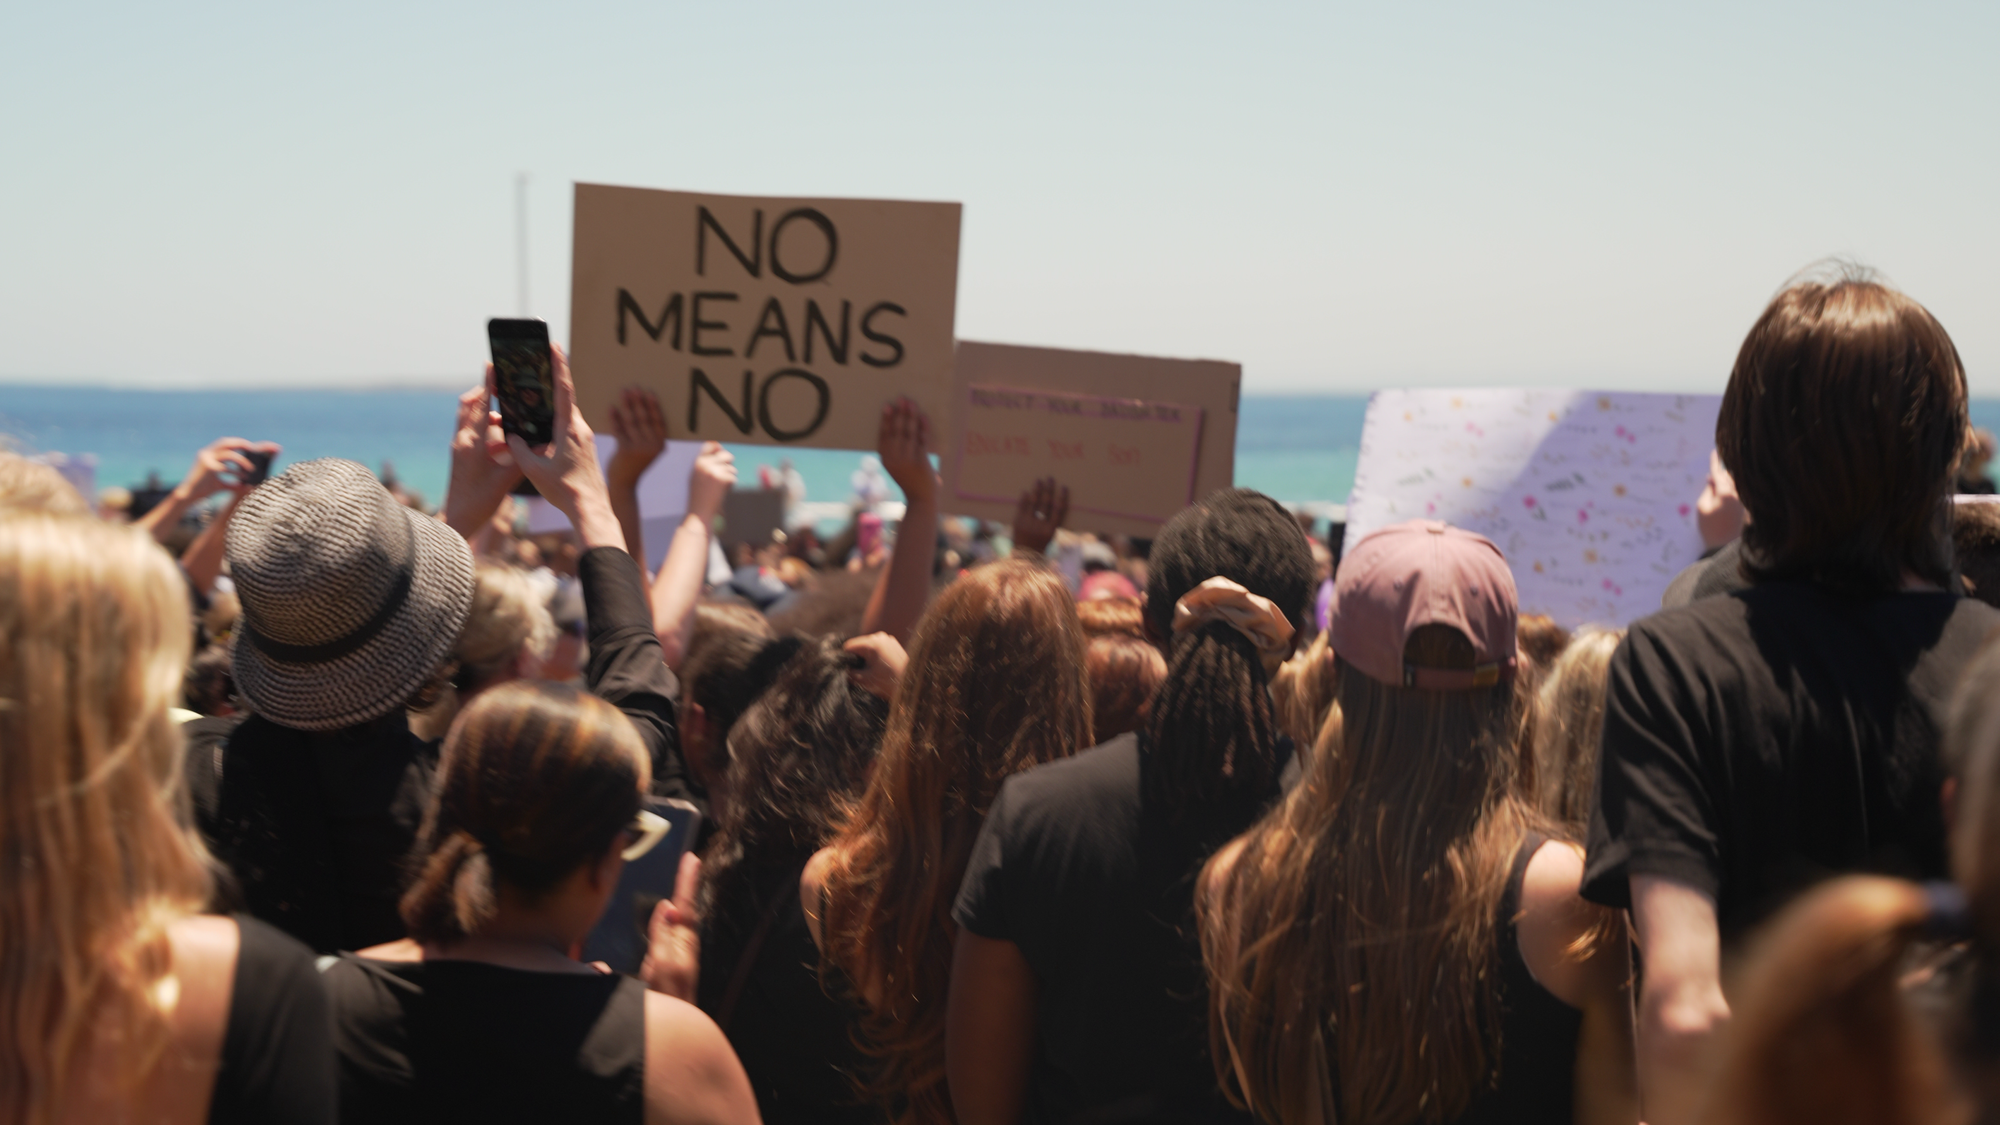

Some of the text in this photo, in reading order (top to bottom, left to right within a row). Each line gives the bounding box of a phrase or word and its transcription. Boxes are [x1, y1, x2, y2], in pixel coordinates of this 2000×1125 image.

[695, 205, 838, 285] NO
[616, 287, 907, 368] MEANS
[687, 366, 831, 441] NO
